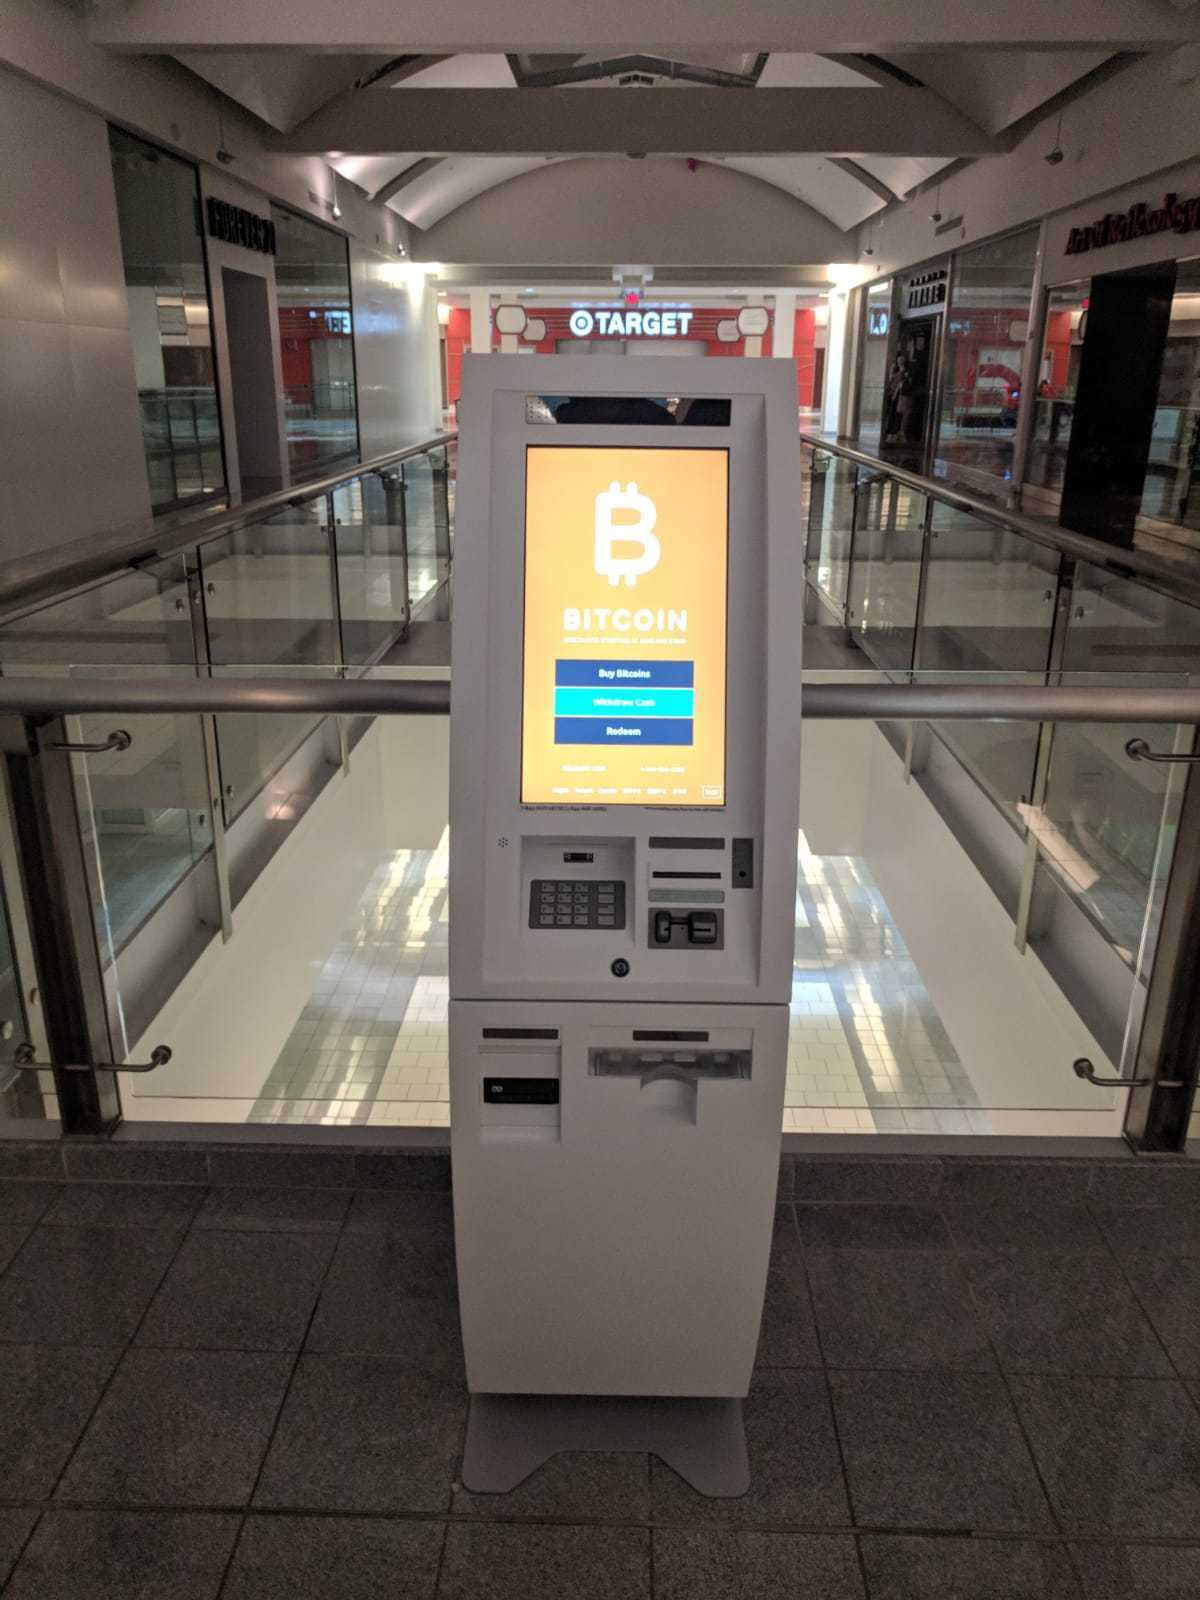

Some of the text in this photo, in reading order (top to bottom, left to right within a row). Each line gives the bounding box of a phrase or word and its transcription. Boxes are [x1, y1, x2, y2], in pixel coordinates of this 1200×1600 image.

[595, 312, 693, 335] TARGET
[563, 607, 688, 632] BITCOIN
[598, 668, 651, 679] Buy Bitcoins
[606, 726, 642, 736] Redeem
